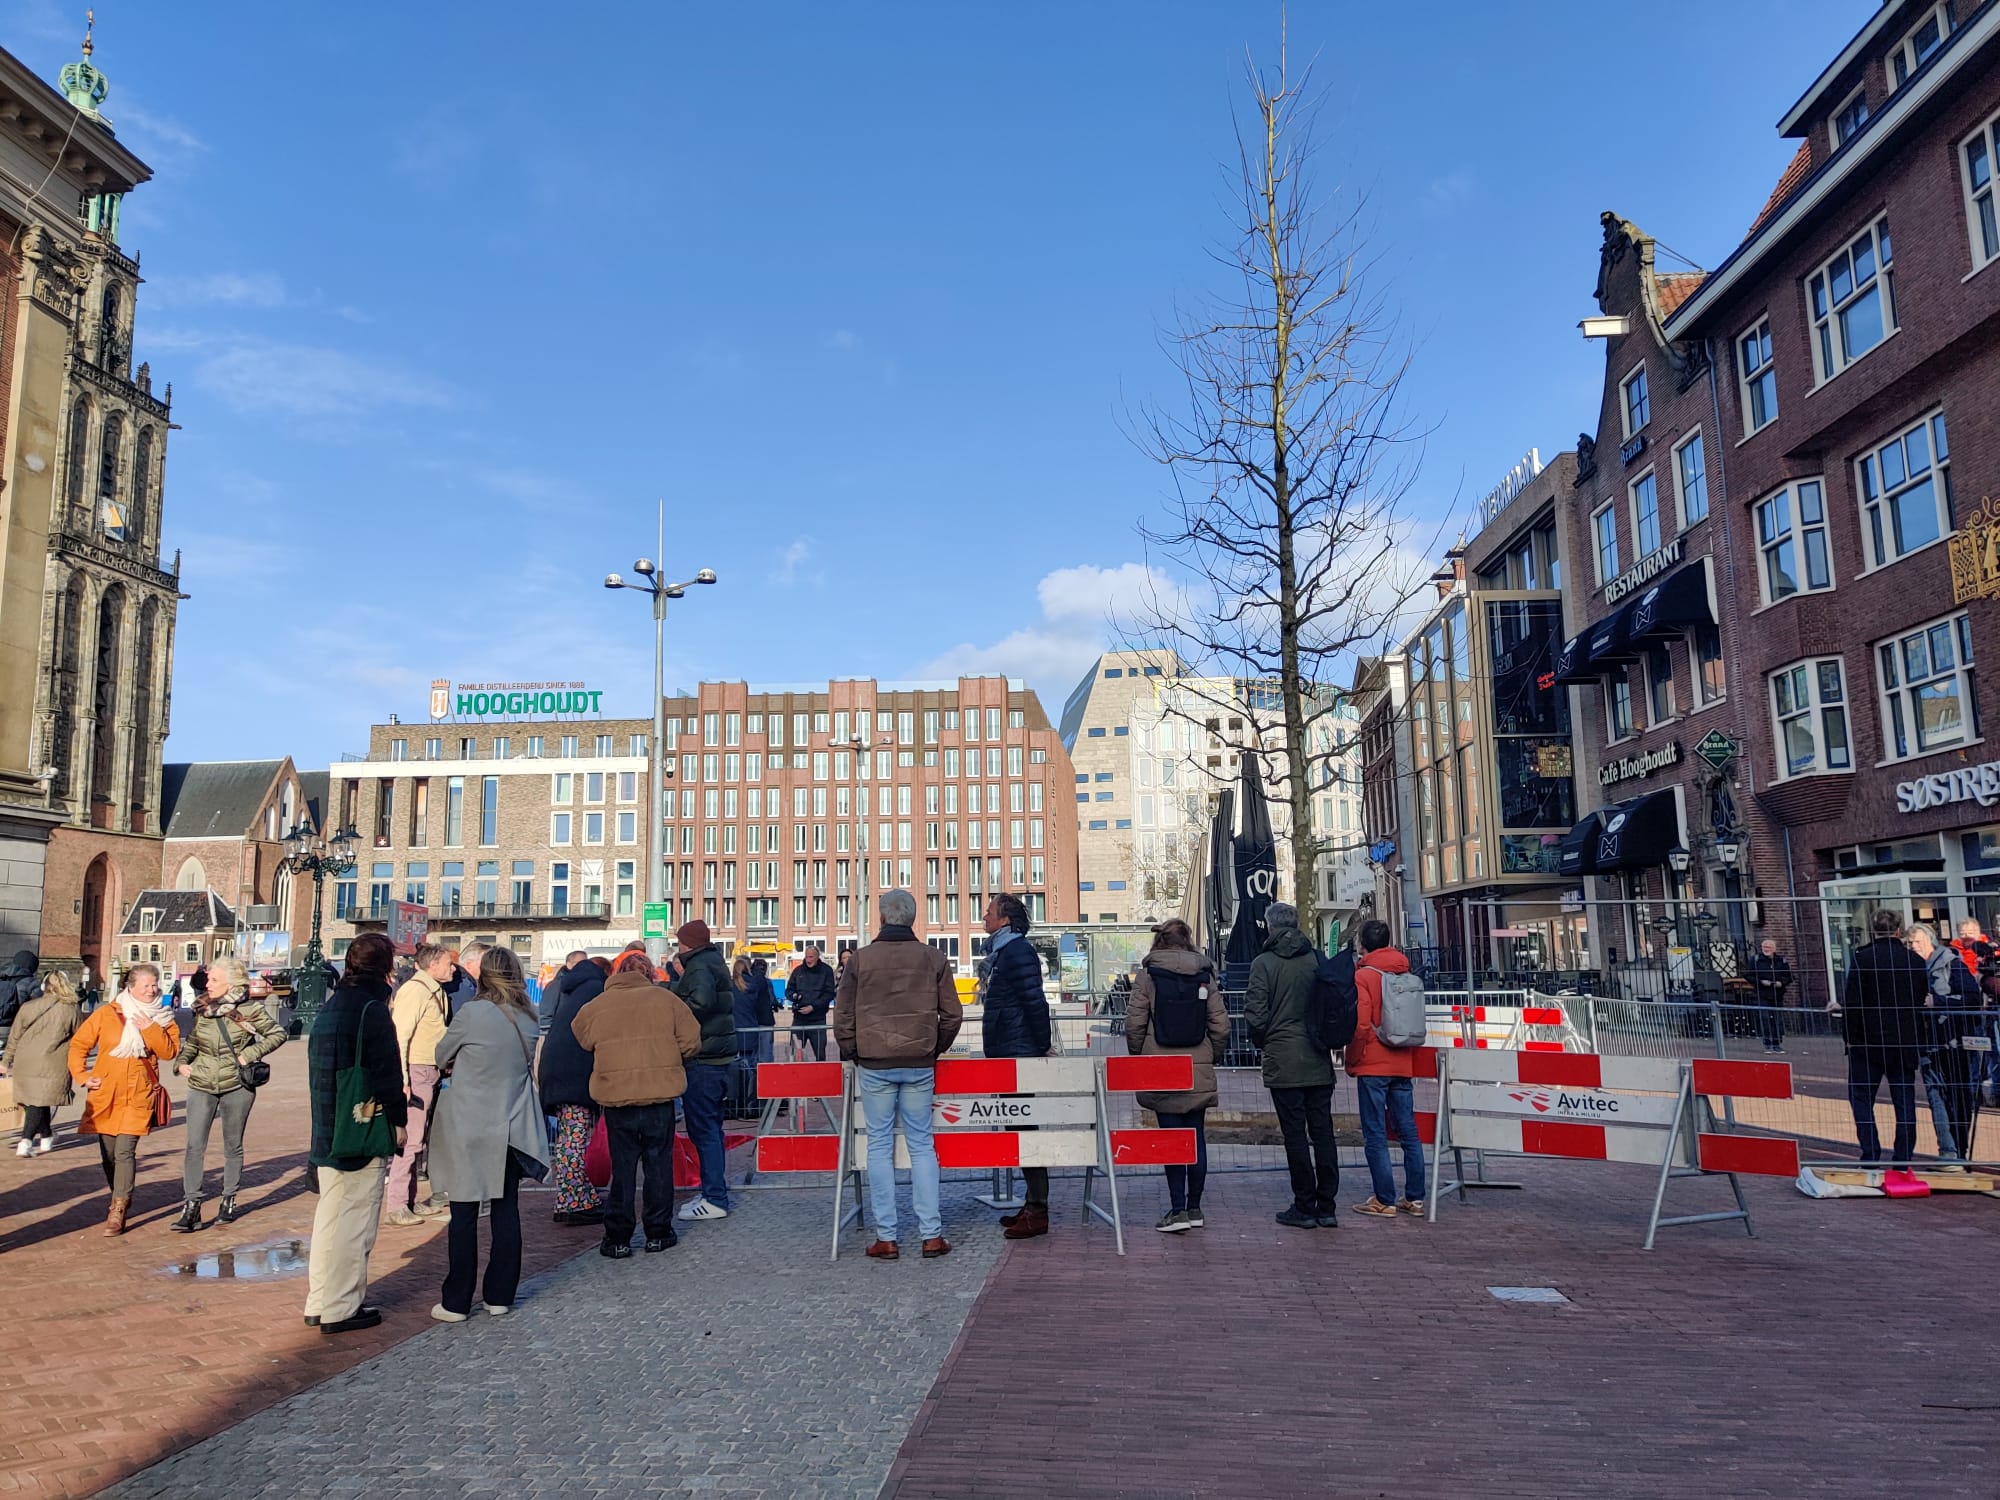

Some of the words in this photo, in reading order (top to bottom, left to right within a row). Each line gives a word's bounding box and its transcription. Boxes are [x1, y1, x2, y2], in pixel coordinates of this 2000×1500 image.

[1604, 538, 1681, 605] RESTAURANT
[458, 683, 485, 691] FAMILIE
[457, 691, 603, 715] HOOGHOUDT
[1703, 740, 1729, 750] Brand
[1597, 760, 1618, 786] Café
[1618, 742, 1677, 778] Hooghoudt
[1896, 761, 2000, 813] SØSTRE
[969, 1100, 1031, 1117] Avitec
[1557, 1093, 1619, 1112] Avitec
